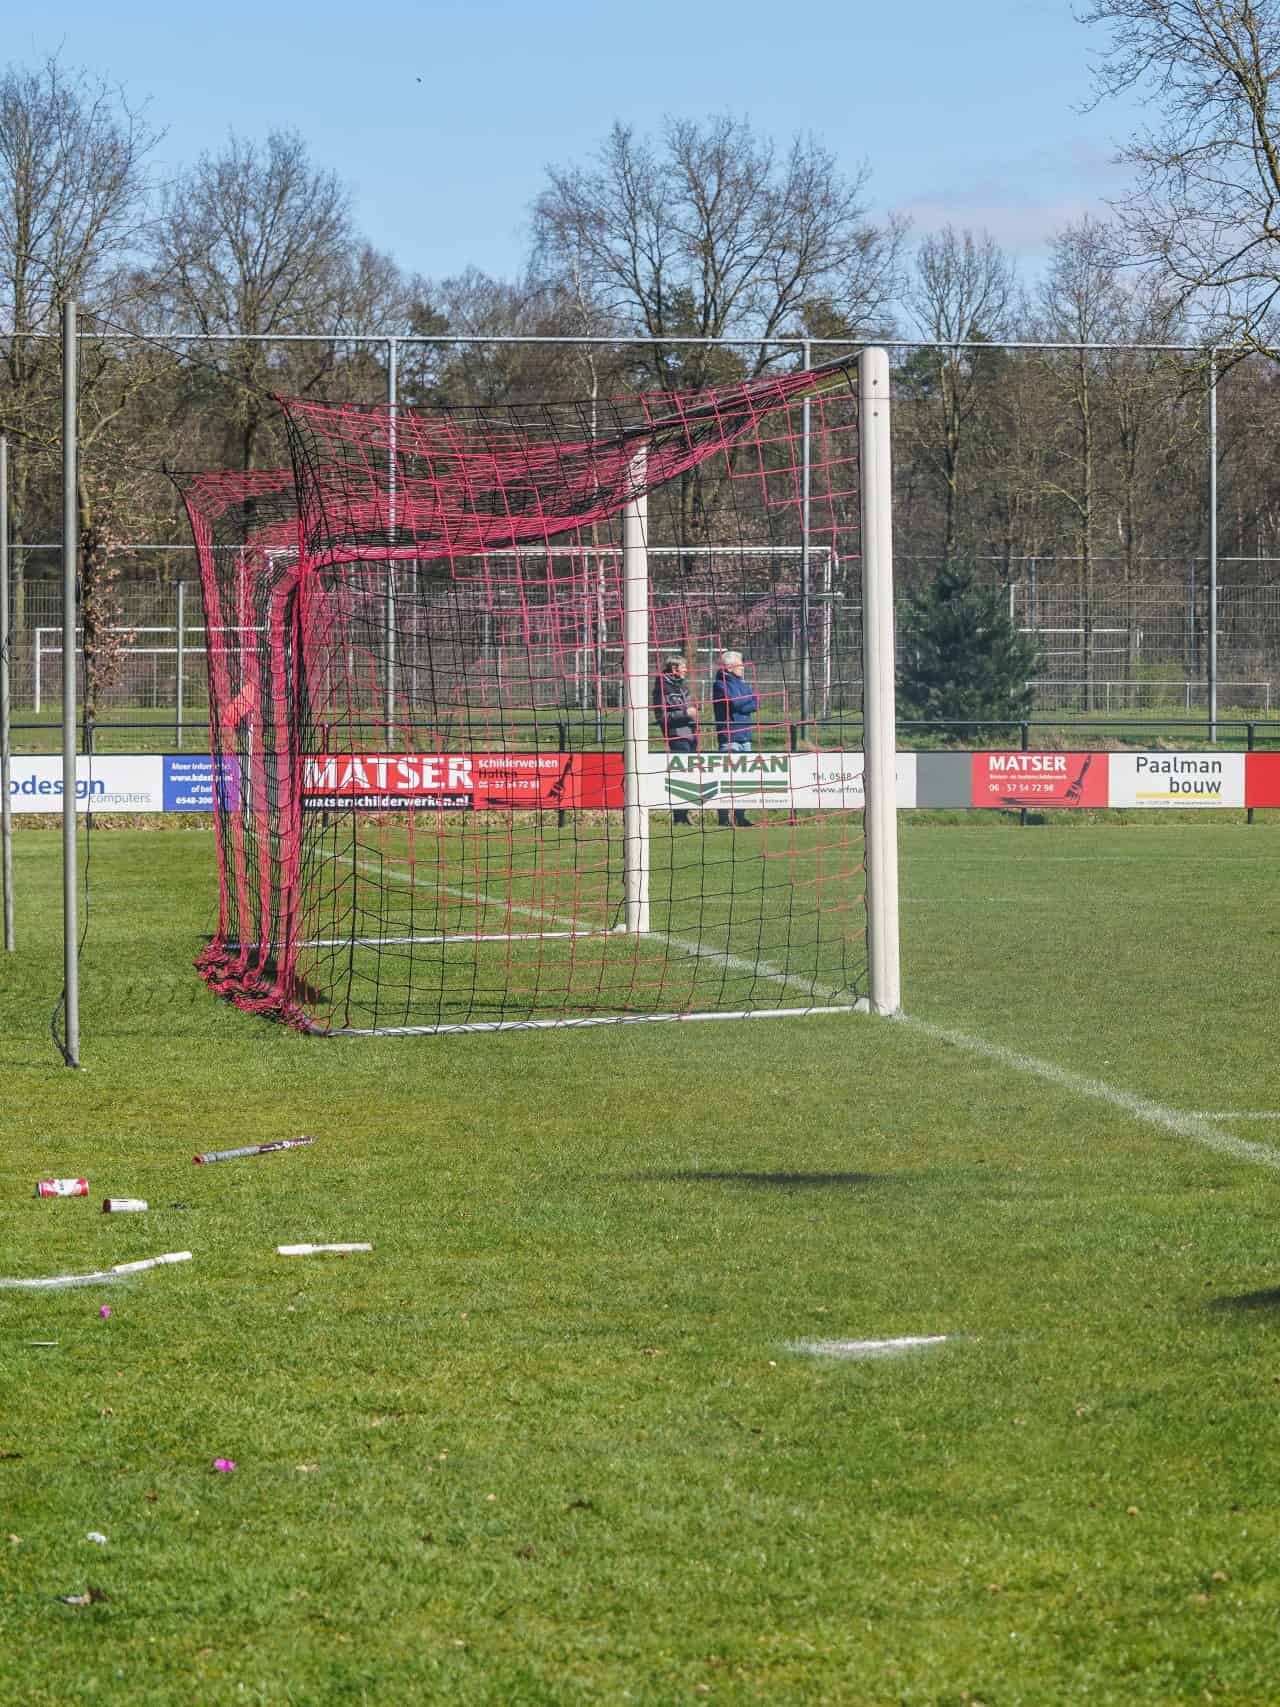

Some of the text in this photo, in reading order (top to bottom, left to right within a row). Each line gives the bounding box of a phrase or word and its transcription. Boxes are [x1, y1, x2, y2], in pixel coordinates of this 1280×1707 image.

[667, 755, 789, 773] ARFMAN
[988, 755, 1067, 771] MATSER
[1135, 756, 1223, 774] Paalman
[303, 757, 474, 790] MATSER
[9, 774, 105, 799] desgn
[1168, 776, 1223, 794] bouw
[91, 791, 152, 804] computers
